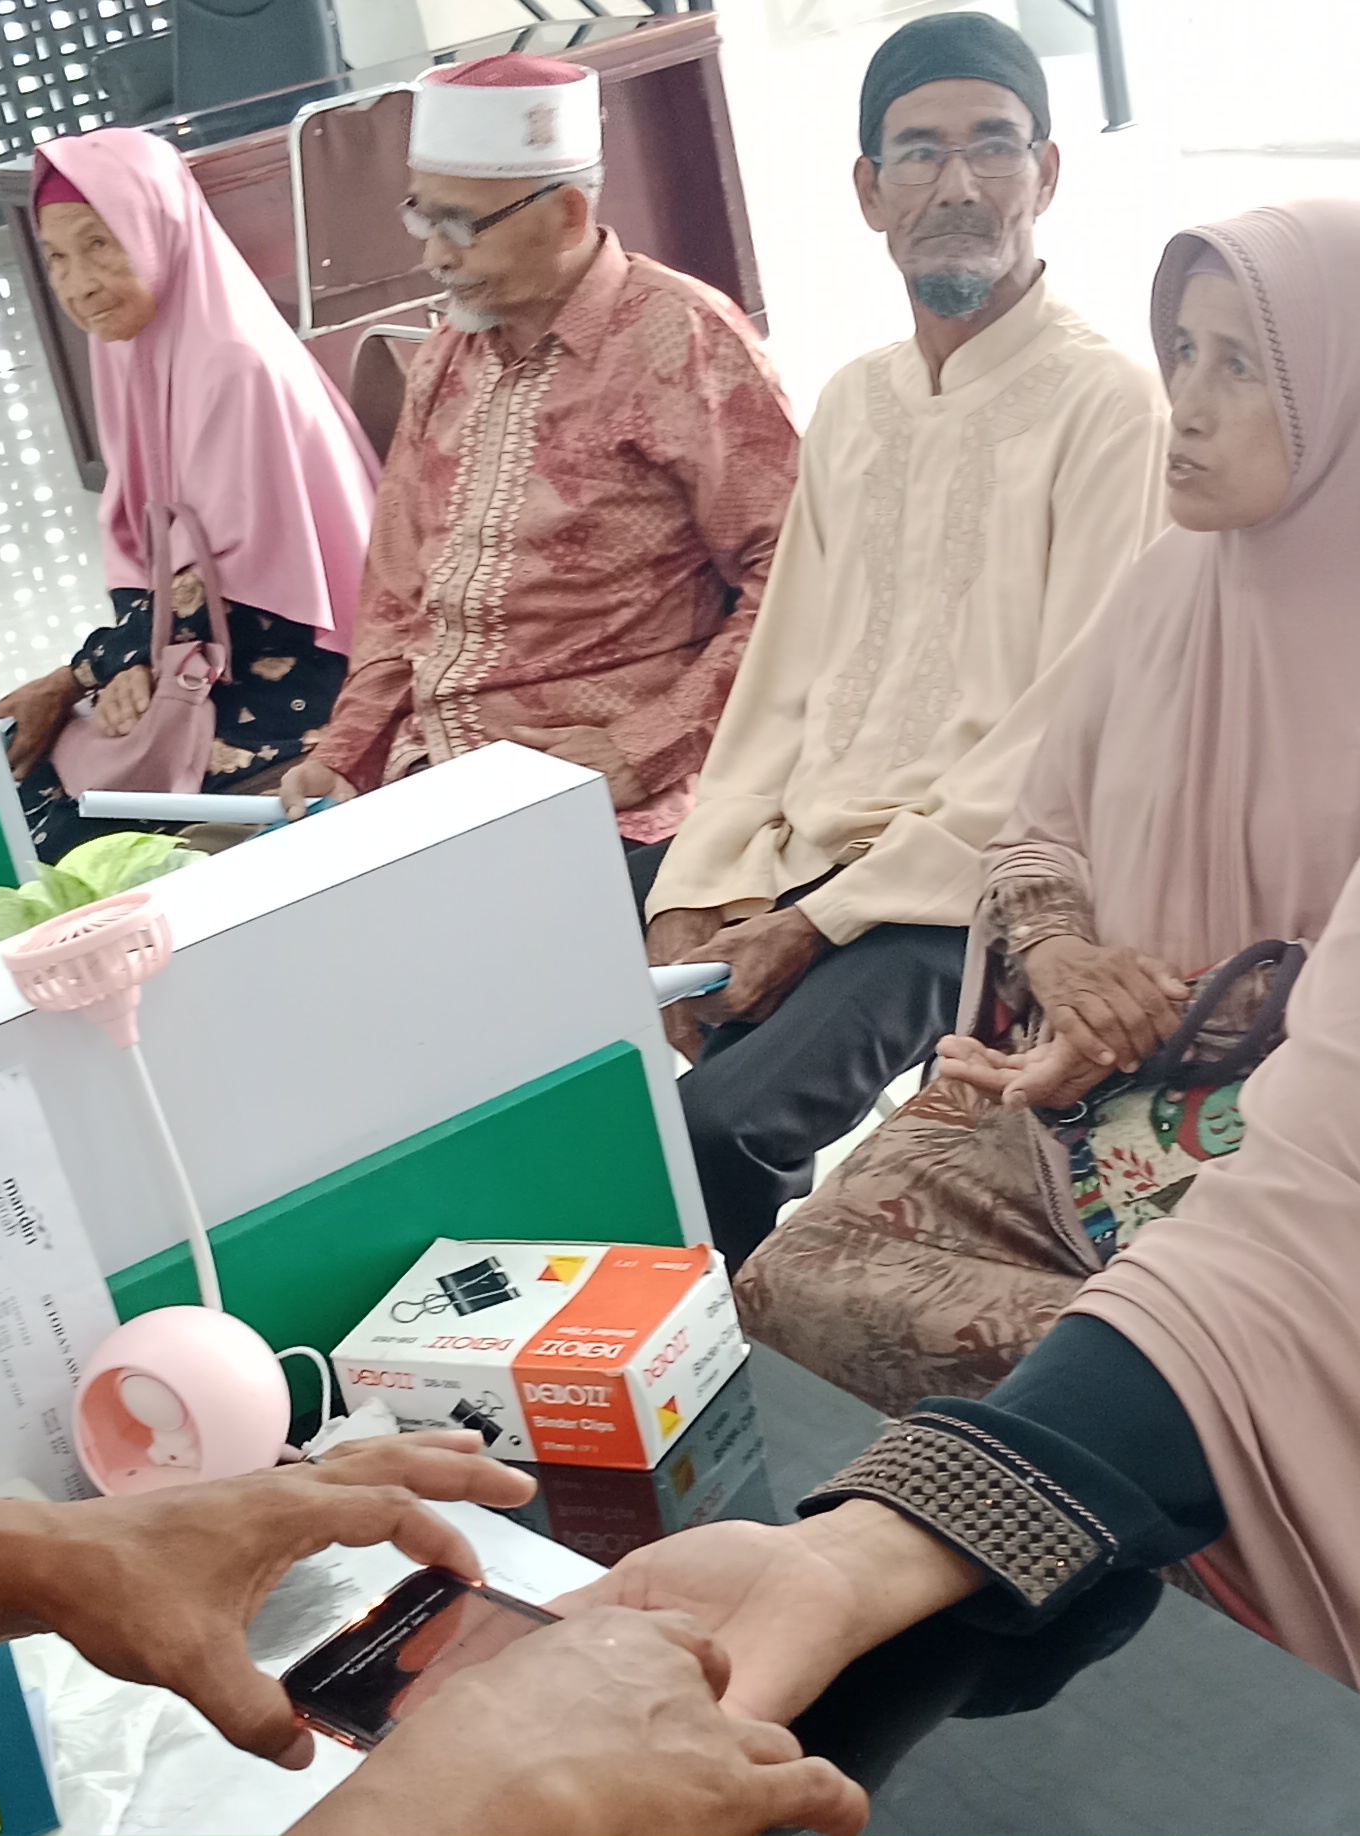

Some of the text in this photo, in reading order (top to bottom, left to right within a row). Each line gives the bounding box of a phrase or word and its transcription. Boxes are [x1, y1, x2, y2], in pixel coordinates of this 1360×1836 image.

[2, 1177, 38, 1246] mandiri
[534, 1415, 617, 1432] Binder Clips
